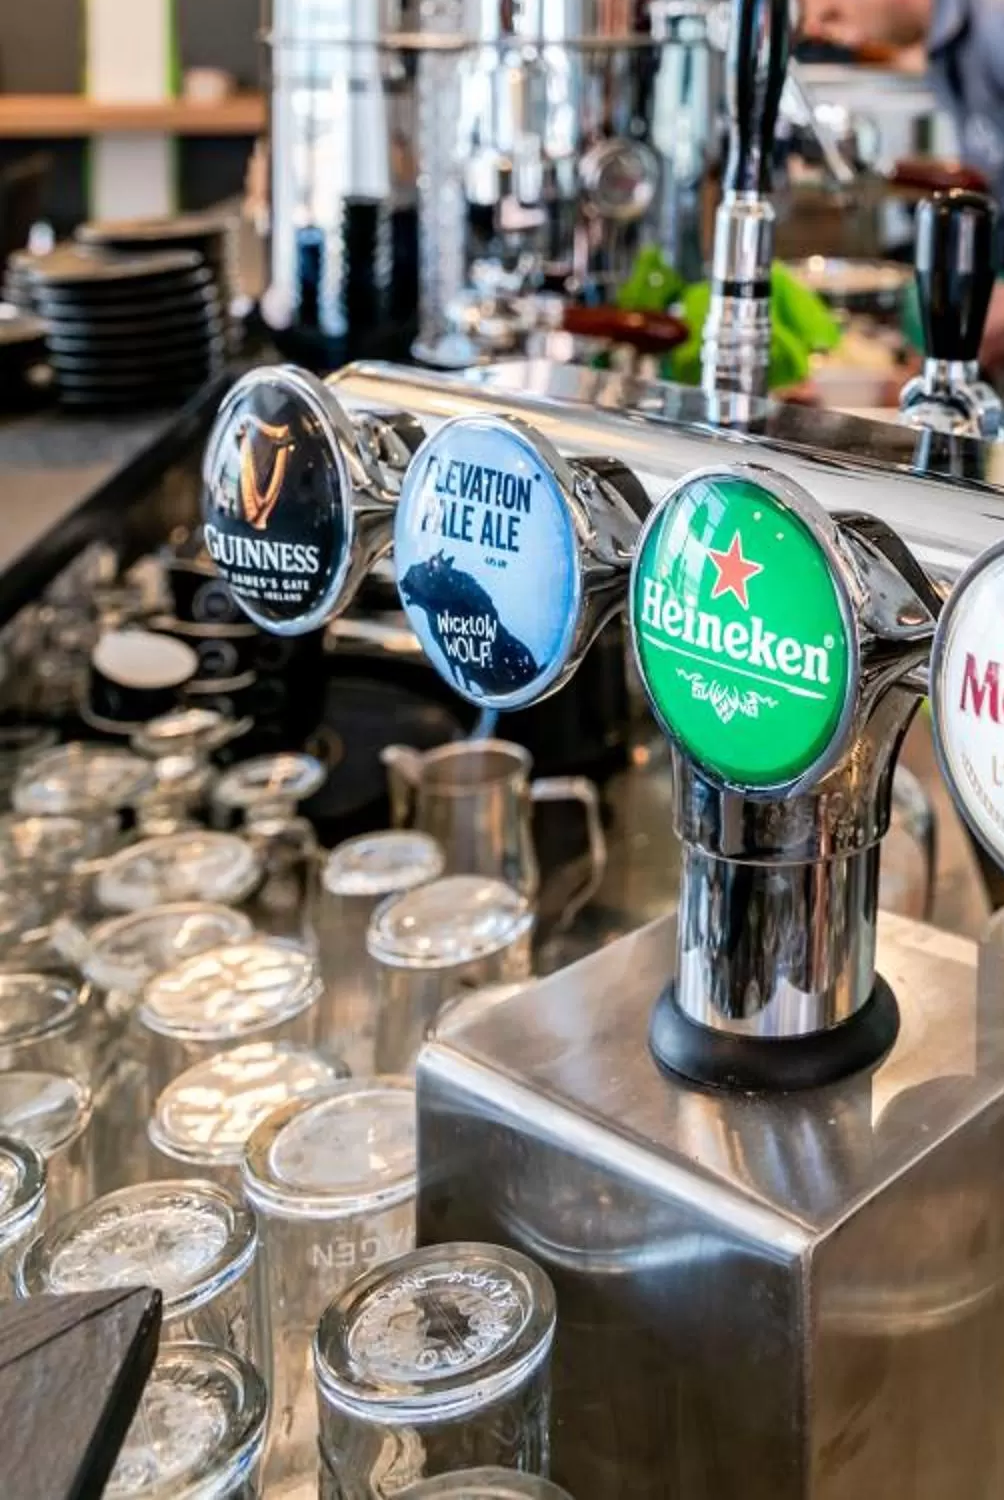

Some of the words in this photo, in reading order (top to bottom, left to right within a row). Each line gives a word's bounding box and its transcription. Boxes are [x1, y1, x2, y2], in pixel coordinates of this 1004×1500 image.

[203, 523, 320, 574] GUINNESS
[480, 509, 521, 553] ALE
[443, 635, 493, 669] WOLF
[641, 576, 830, 685] Heineken
